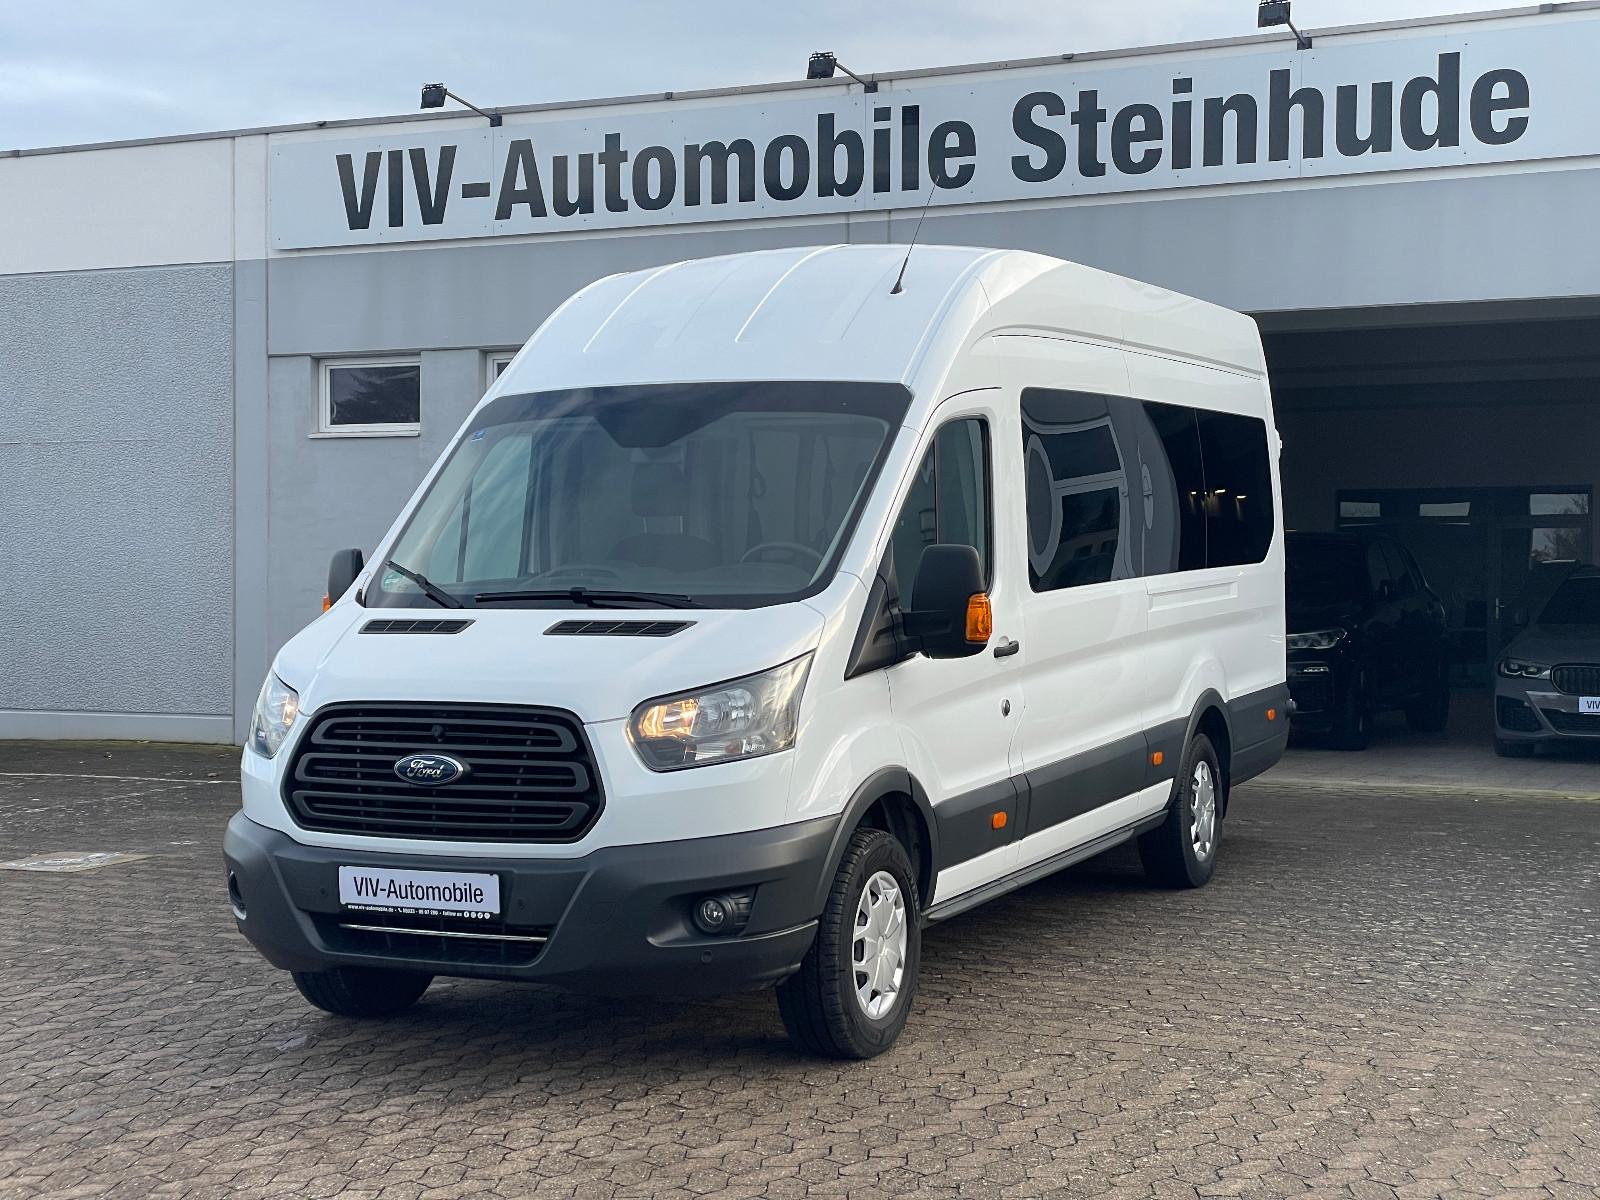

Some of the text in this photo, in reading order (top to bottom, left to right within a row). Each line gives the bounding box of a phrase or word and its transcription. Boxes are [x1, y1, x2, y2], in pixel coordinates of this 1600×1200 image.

[336, 52, 1530, 231] VIV-Automobile Steinhude
[406, 759, 445, 778] Ford
[353, 876, 484, 904] VIV-Automobile
